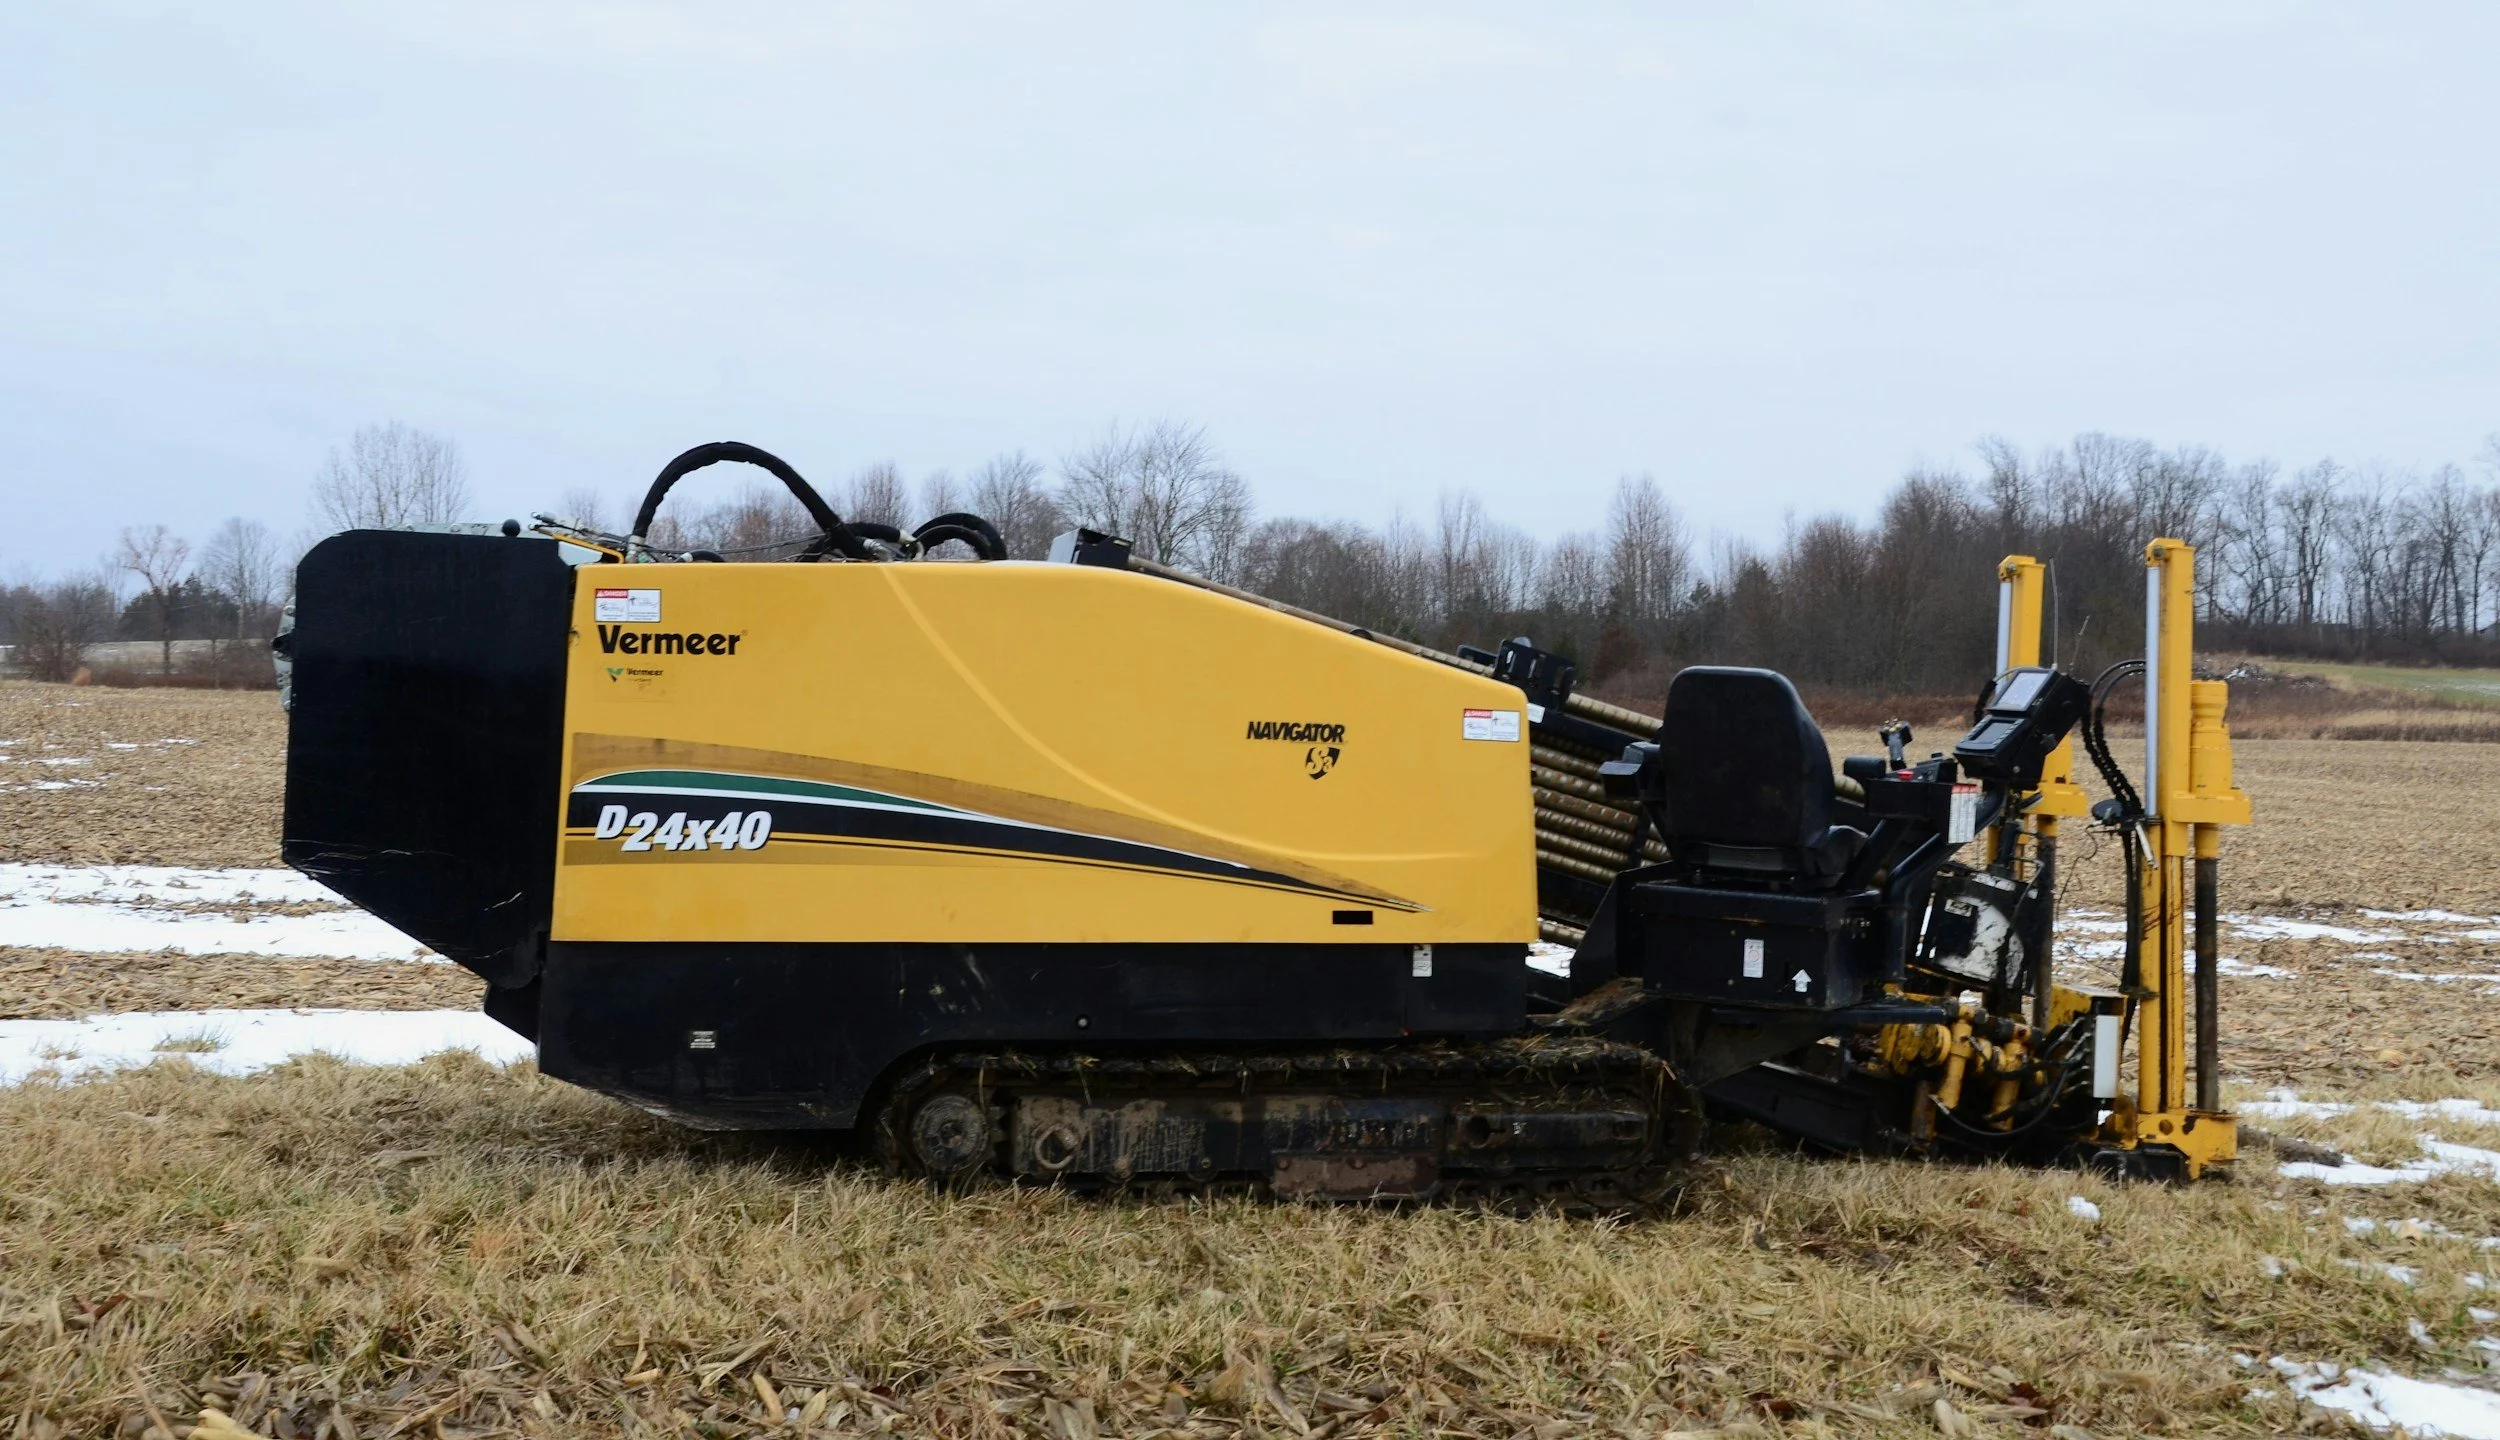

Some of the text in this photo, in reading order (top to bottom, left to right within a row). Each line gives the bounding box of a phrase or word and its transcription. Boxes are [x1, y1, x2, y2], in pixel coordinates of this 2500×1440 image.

[597, 624, 741, 656] Vermeer
[1246, 721, 1345, 743] NAVIGATOR
[593, 804, 773, 852] D24x40
